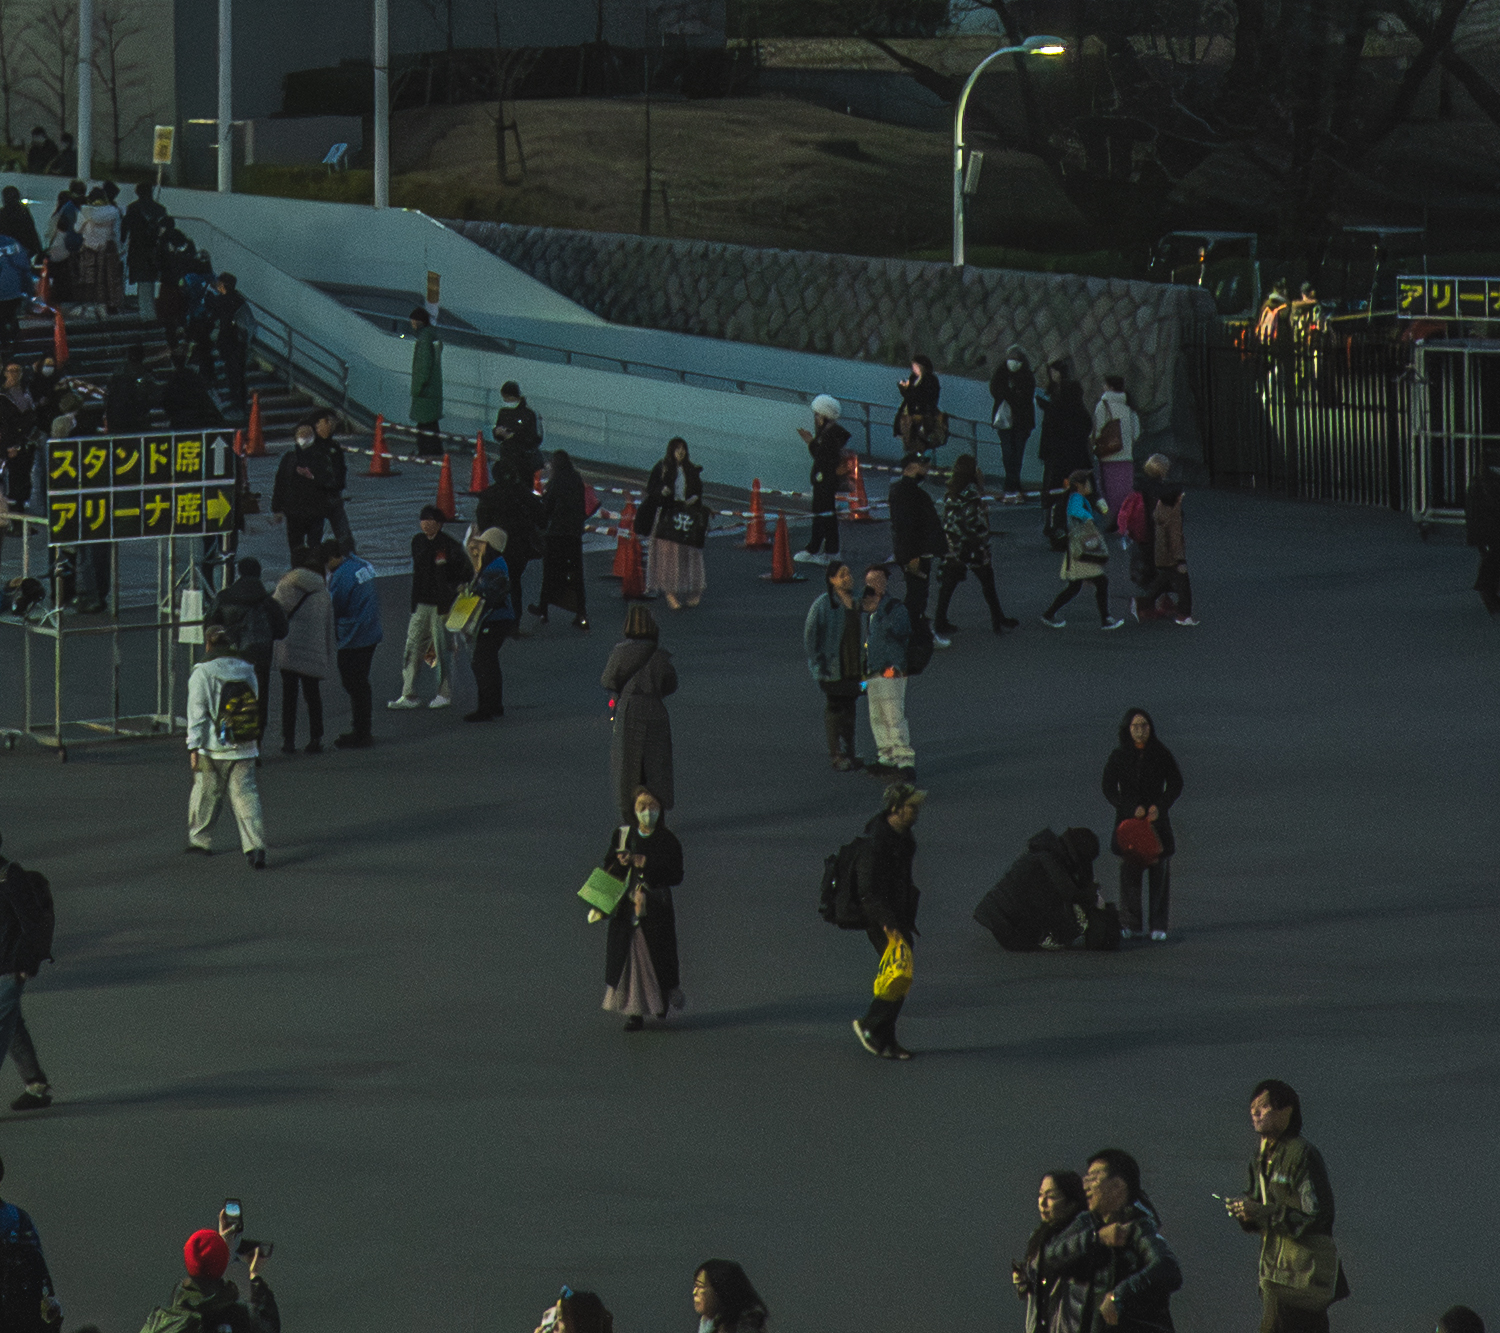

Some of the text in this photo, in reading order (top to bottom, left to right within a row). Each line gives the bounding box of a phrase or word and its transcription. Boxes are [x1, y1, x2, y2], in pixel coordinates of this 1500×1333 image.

[51, 440, 201, 479] スタンド席
[52, 493, 202, 532] アリーナ席
